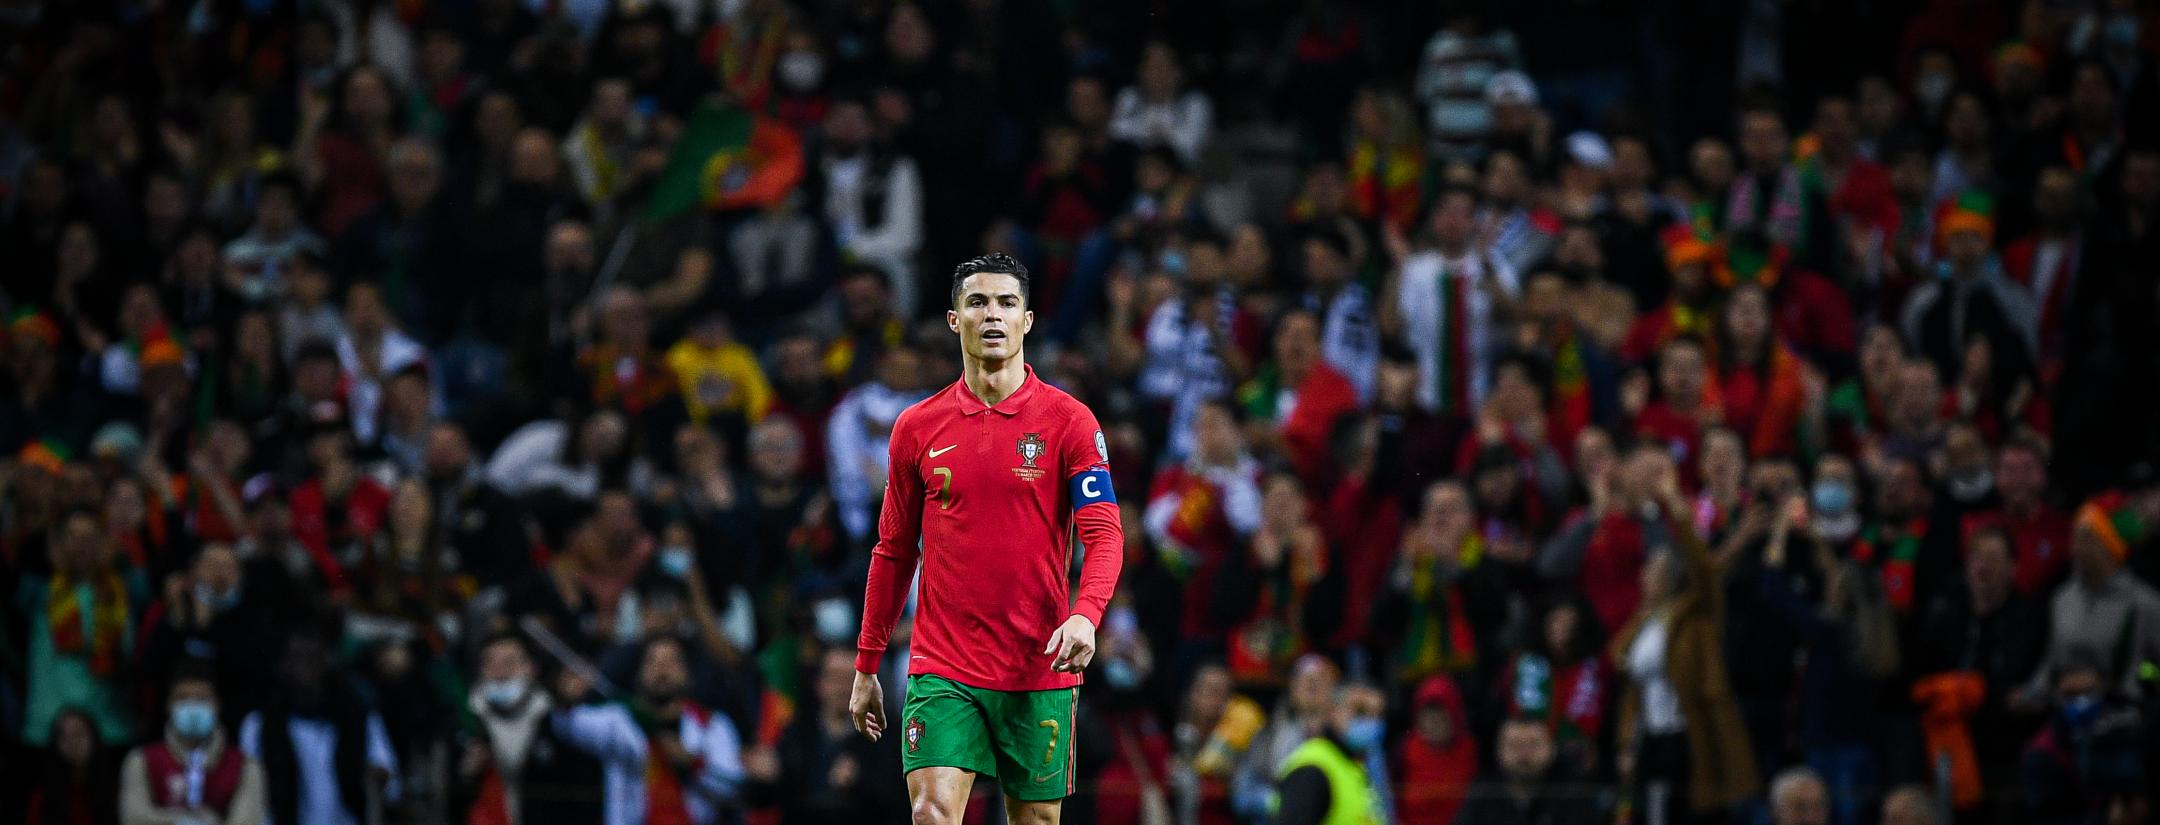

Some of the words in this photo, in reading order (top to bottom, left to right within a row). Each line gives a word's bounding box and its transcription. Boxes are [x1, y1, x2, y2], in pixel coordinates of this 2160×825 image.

[933, 467, 952, 510] 7
[1081, 475, 1101, 498] C
[1039, 719, 1059, 765] 7
